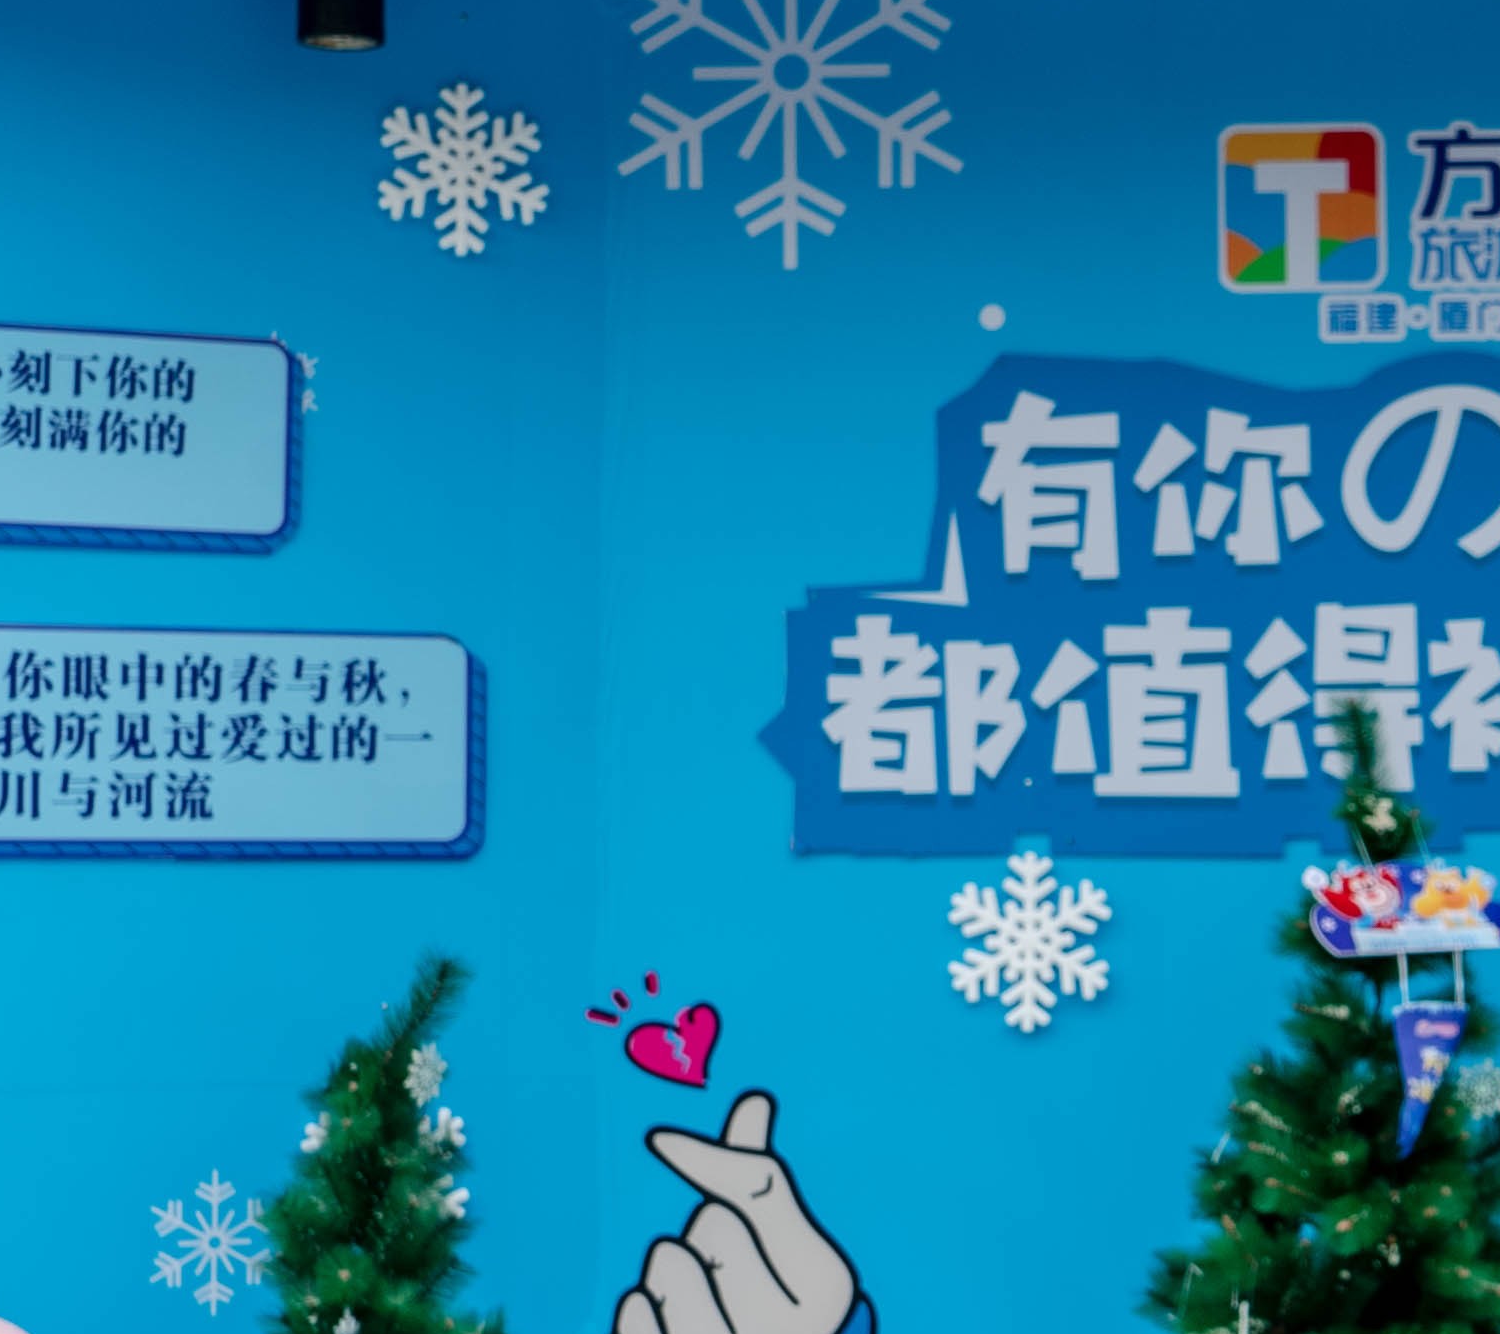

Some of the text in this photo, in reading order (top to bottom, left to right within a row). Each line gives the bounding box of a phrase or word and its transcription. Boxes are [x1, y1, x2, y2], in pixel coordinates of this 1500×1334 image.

[3, 649, 411, 708] 你眼中的春与秋，
